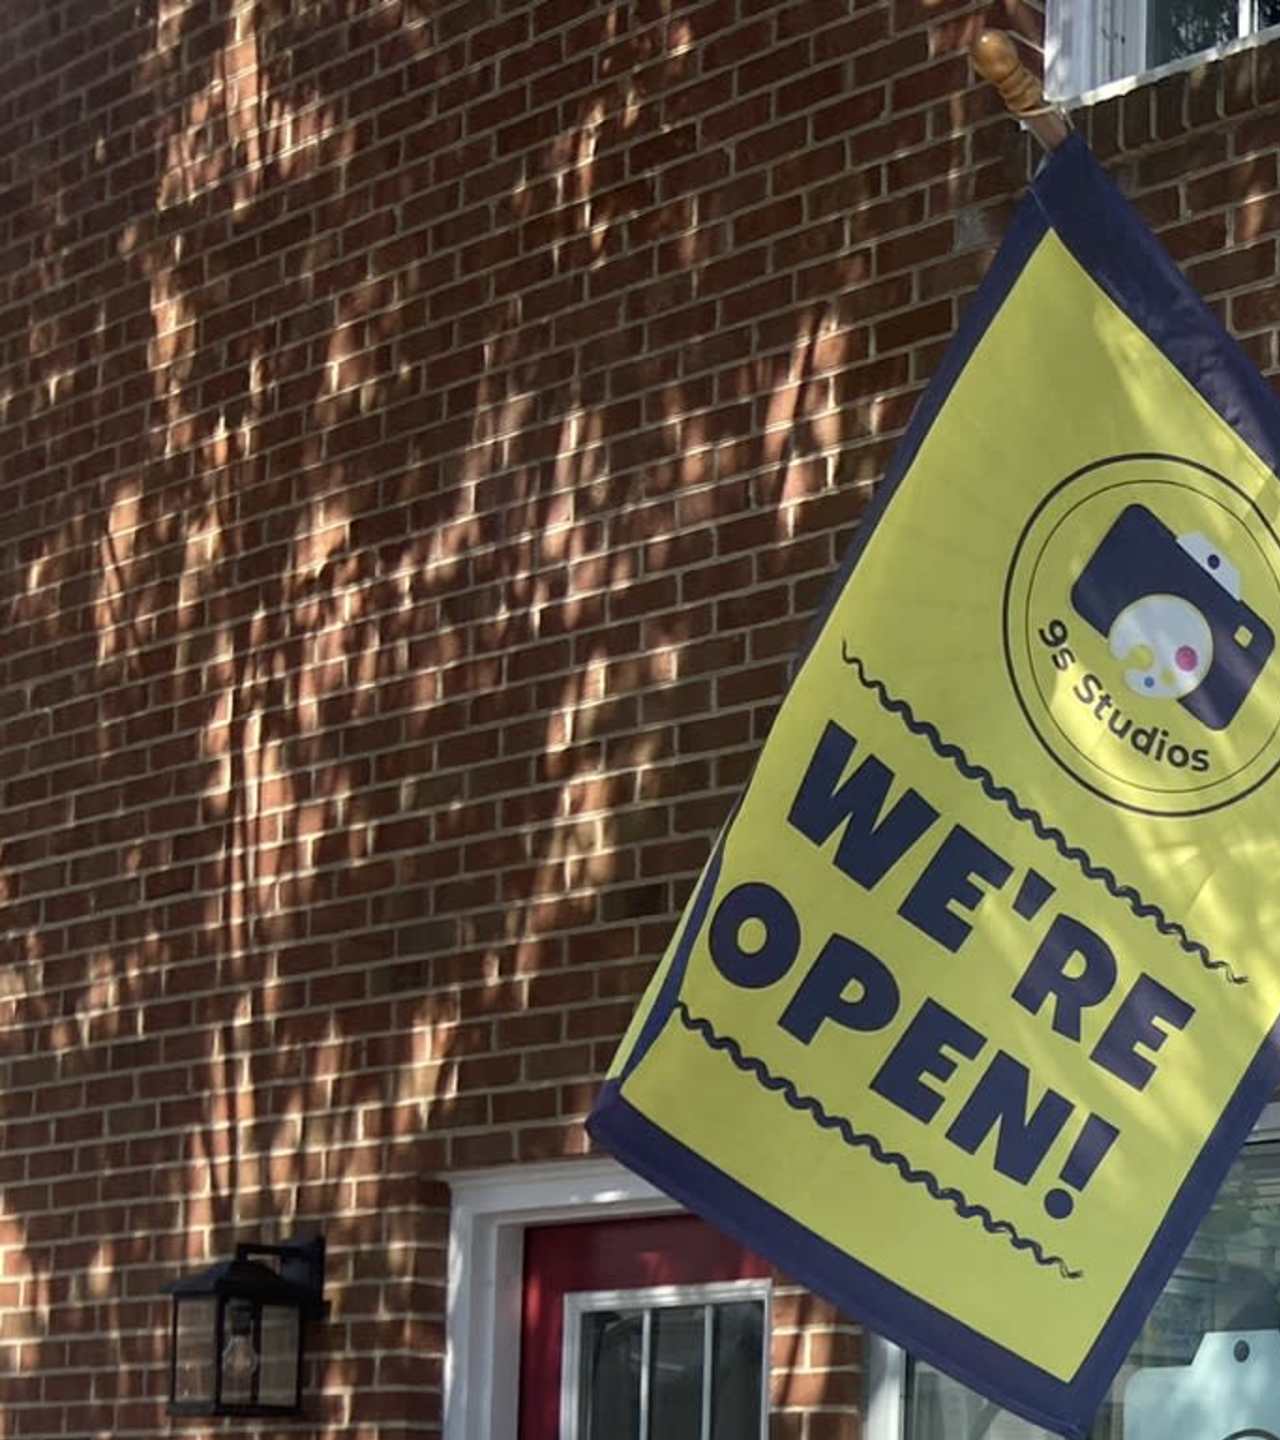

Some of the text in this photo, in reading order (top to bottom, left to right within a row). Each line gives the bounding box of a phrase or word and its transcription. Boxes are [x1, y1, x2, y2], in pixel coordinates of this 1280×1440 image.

[1038, 619, 1210, 773] 9s Studios
[708, 882, 1120, 1221] OPEN!
[786, 719, 1195, 1092] WE'RE
